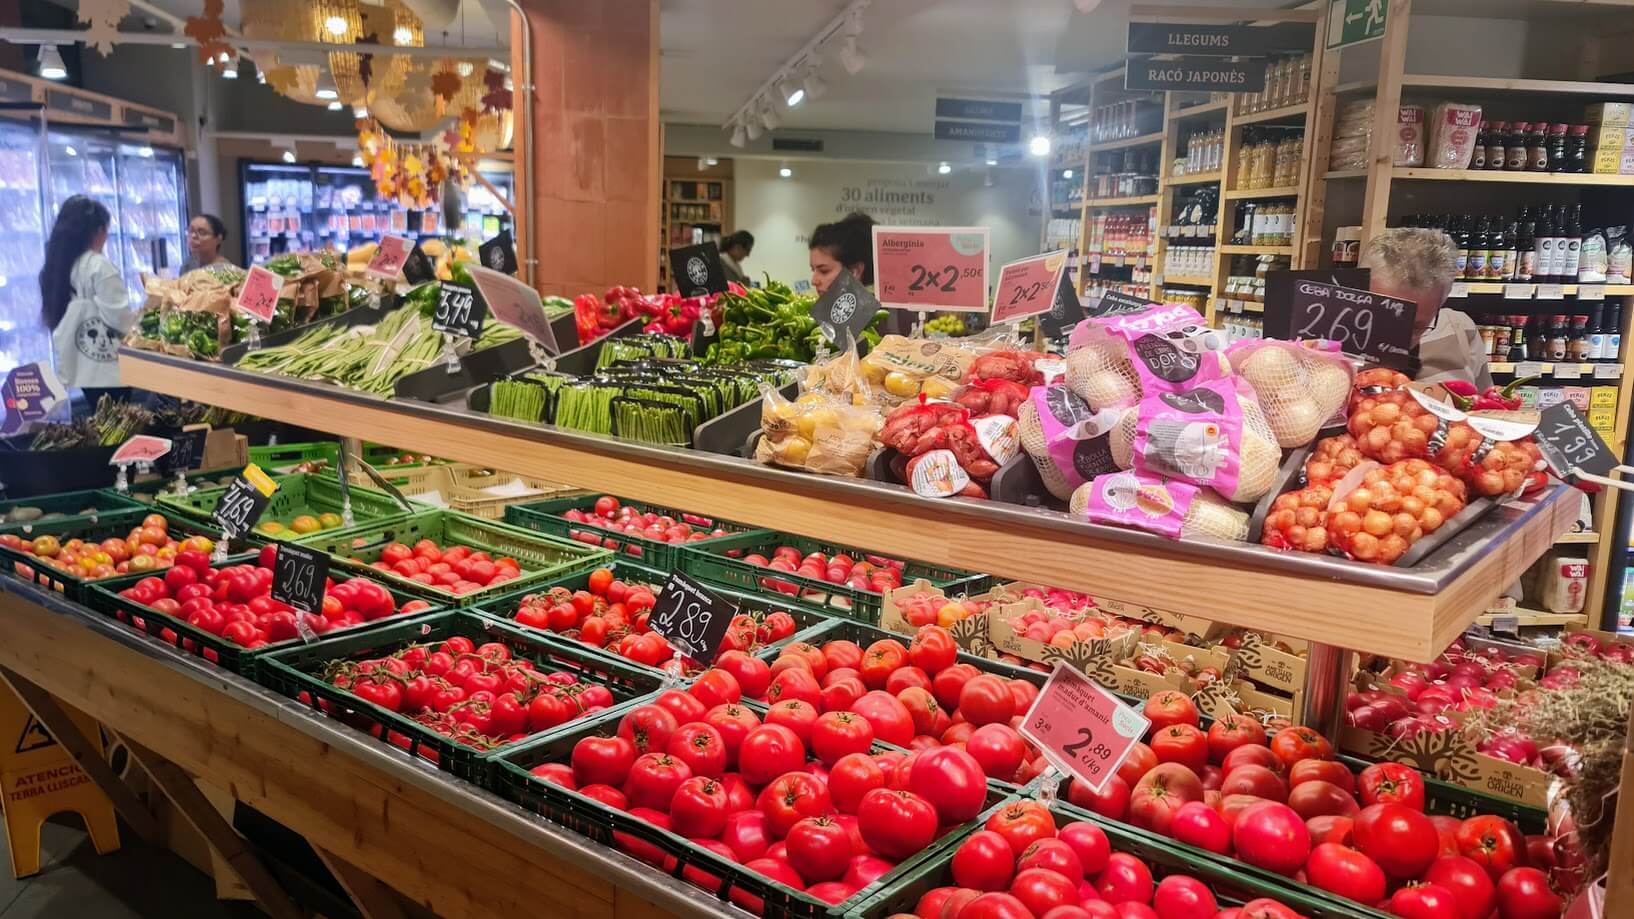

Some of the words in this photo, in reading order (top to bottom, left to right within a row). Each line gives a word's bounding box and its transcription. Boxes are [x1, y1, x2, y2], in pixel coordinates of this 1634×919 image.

[1168, 33, 1230, 47] LLEGUMS
[1148, 66, 1183, 82] RACÓ
[1186, 69, 1247, 85] JAPONÈS
[841, 186, 862, 202] 30
[864, 187, 935, 205] aliments
[879, 206, 916, 218] vegetal
[1299, 283, 1330, 298] CEBA
[1298, 302, 1374, 351] 2,69
[1149, 351, 1178, 369] DOP
[16, 384, 41, 393] 100%
[1546, 422, 1597, 464] 1,99
[222, 485, 255, 526] 4,69
[283, 559, 315, 600] 2,69
[658, 589, 714, 644] 2,89
[9, 785, 47, 802] TERRA
[1486, 781, 1524, 799] ORIGEN
